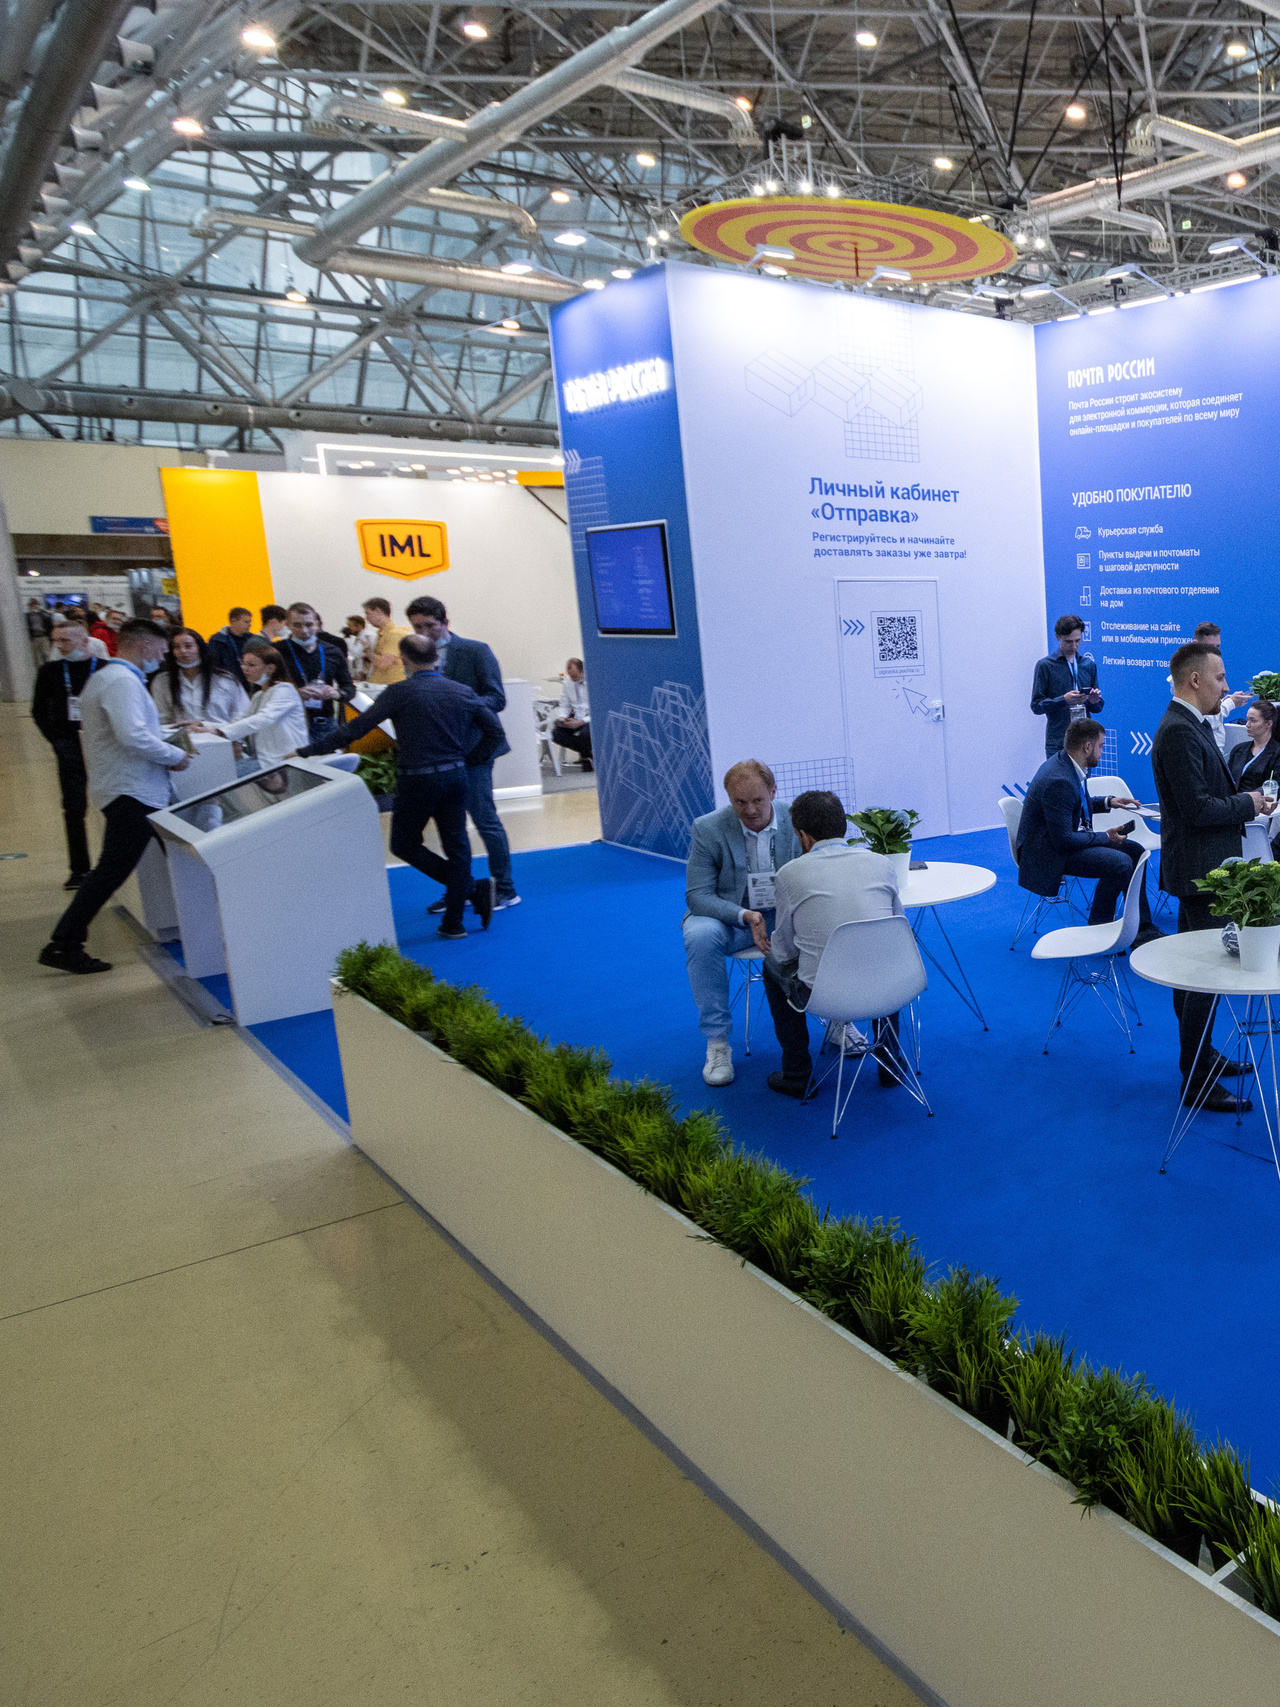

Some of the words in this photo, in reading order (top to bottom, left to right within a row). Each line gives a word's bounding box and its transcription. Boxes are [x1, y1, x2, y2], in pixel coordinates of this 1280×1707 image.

[1067, 366, 1104, 389] ПОЧТА
[1107, 357, 1155, 382] РОССИИ
[1069, 400, 1089, 411] Почта
[1090, 397, 1114, 408] России
[1115, 393, 1139, 405] строит
[1140, 387, 1183, 402] экосистему
[1069, 415, 1082, 425] для
[1083, 407, 1126, 422] электронной
[1126, 403, 1169, 416] коммерции,
[1170, 398, 1201, 411] которая
[1201, 392, 1243, 406] соединяет
[1069, 422, 1130, 436] онлайн-площадки
[1131, 421, 1136, 429] и
[1136, 413, 1183, 428] покупателей
[1183, 413, 1194, 424] по
[1194, 409, 1219, 422] всему
[1219, 407, 1240, 419] миру
[808, 477, 886, 498] Личный
[890, 483, 960, 503] кабинет
[1072, 490, 1114, 507] УДОБНО
[1116, 483, 1192, 502] ПОКУПАТЕЛЮ
[811, 502, 919, 526] «Отправка»
[1097, 526, 1137, 538] Курьерская
[1137, 523, 1164, 537] служба
[380, 534, 431, 557] IML
[812, 531, 897, 545] Регистрируйтесь
[907, 536, 955, 546] начинайте
[813, 548, 873, 558] доставлять
[875, 549, 911, 558] заказы
[913, 550, 932, 560] уже
[933, 549, 967, 560] завтра!
[1098, 550, 1124, 561] Пункты
[1125, 550, 1152, 560] выдачи
[1153, 550, 1158, 558] и
[1159, 548, 1200, 558] почтоматы
[1099, 564, 1104, 572] в
[1104, 562, 1134, 572] шаговой
[1134, 562, 1180, 573] доступности
[1100, 585, 1132, 596] Доставка
[1133, 586, 1142, 594] из
[1142, 586, 1180, 595] почтового
[1181, 586, 1220, 596] отделения
[1109, 599, 1124, 609] дом
[1101, 621, 1150, 631] Отслеживание
[1150, 623, 1159, 631] на
[1160, 621, 1181, 632] сайте
[1101, 635, 1114, 643] или
[1114, 635, 1120, 643] в
[1120, 634, 1159, 644] мобильном
[1102, 656, 1126, 666] Легкий
[1126, 657, 1155, 668] возврат
[1156, 659, 1171, 668] това
